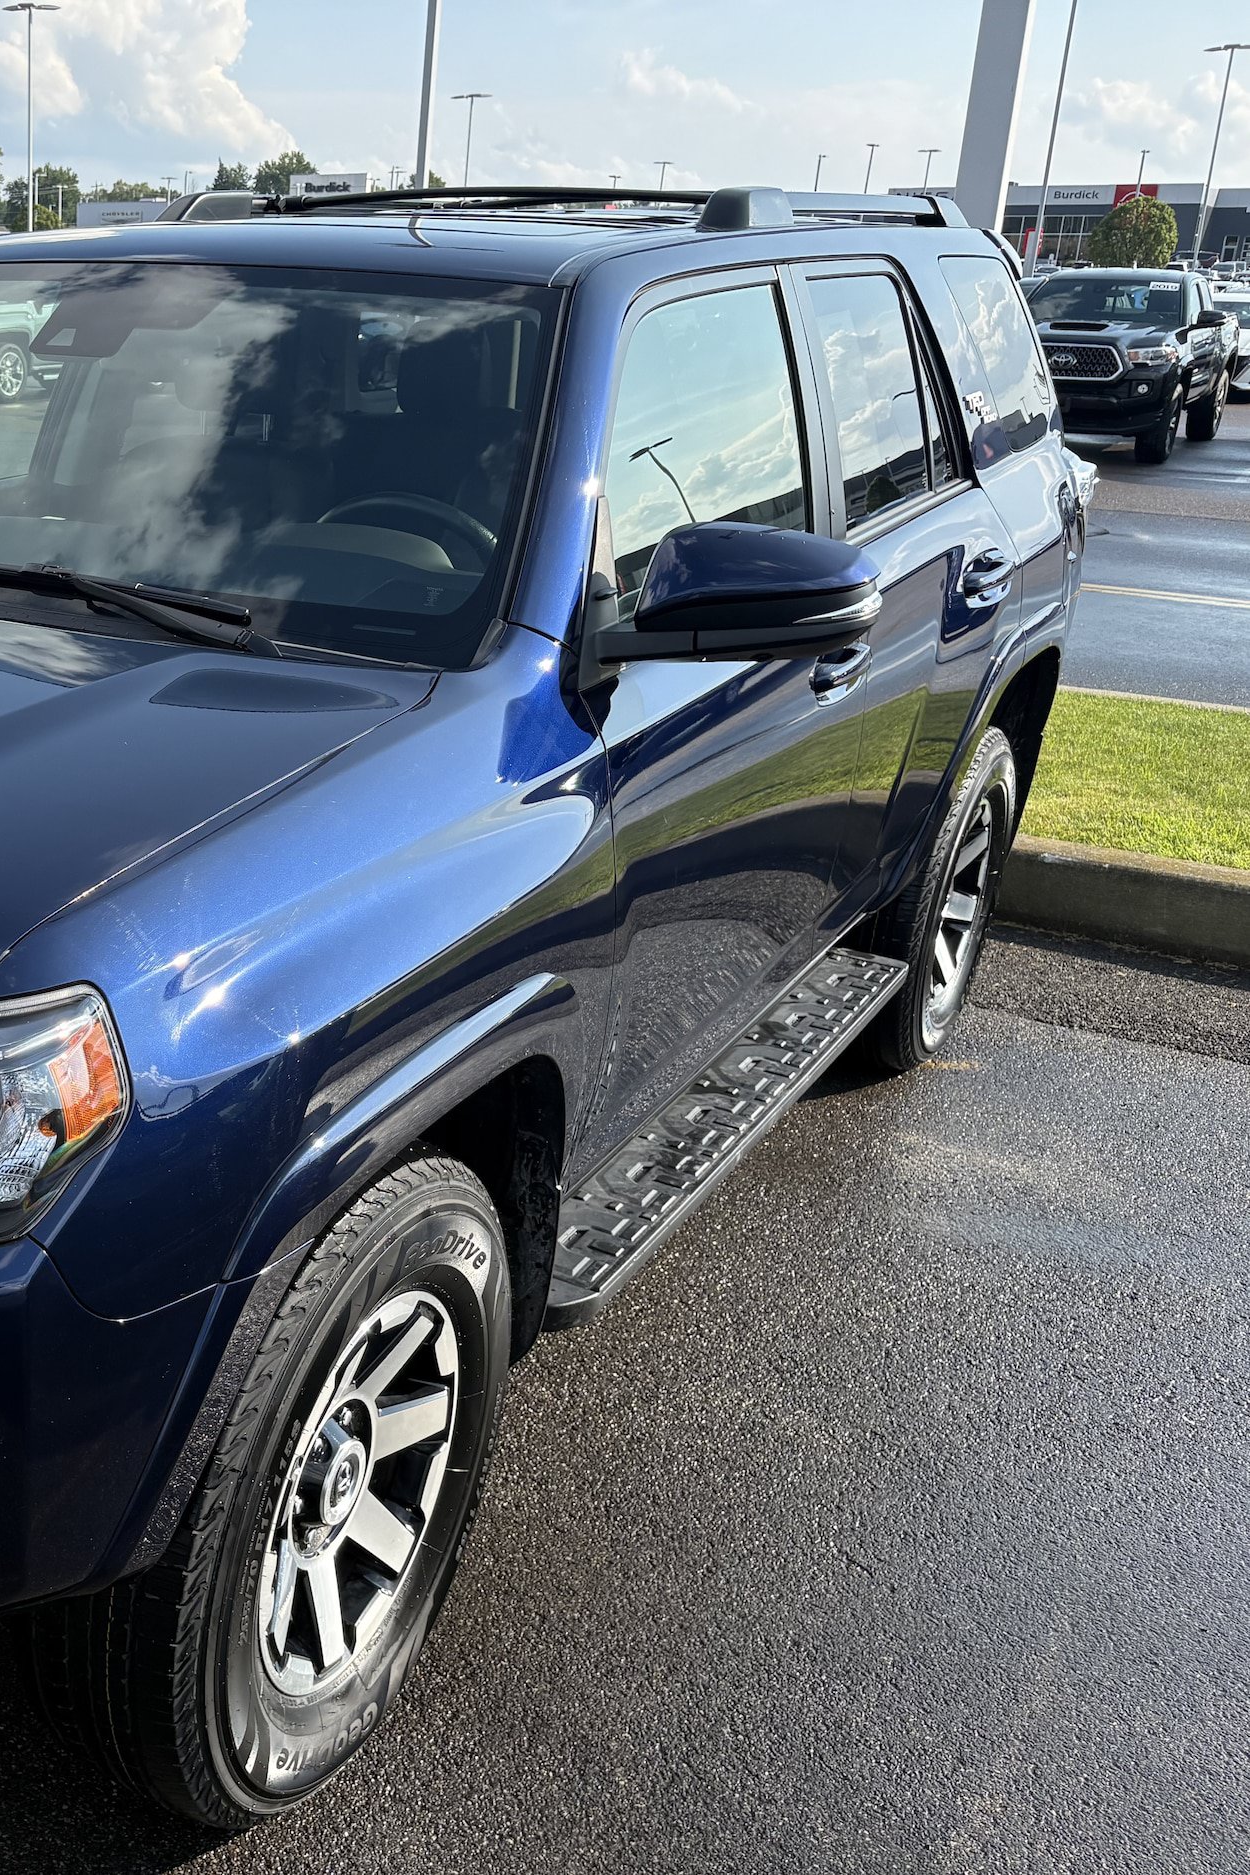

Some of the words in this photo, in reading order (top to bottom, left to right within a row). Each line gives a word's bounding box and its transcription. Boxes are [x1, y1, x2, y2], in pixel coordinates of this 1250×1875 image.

[305, 182, 351, 193] Burdick
[1053, 190, 1099, 200] Burdick
[404, 1229, 487, 1270] GeoDrive
